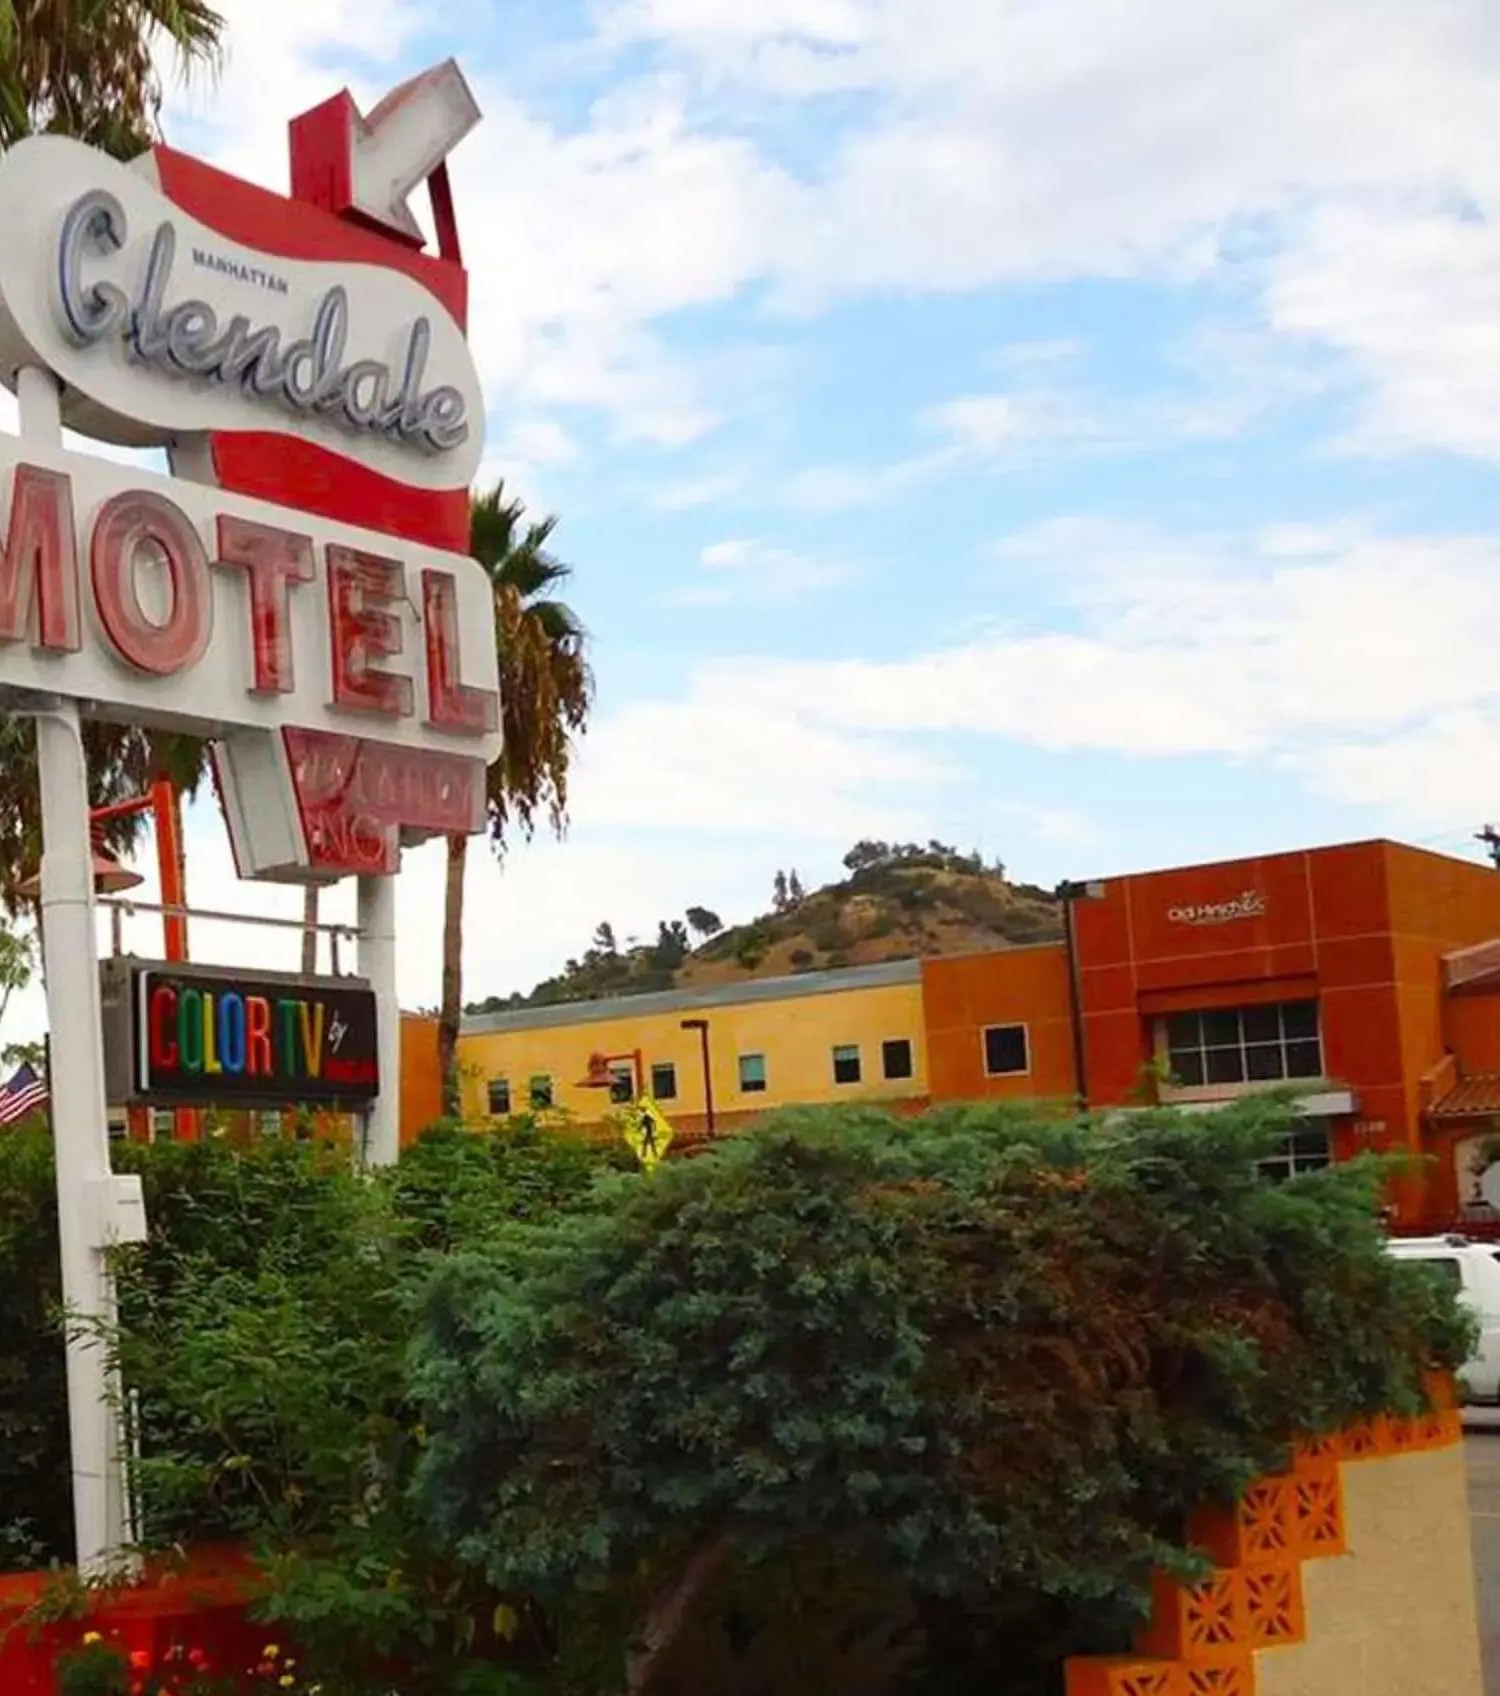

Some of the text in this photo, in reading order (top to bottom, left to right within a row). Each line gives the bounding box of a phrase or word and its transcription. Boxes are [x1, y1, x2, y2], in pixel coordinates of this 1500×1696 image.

[192, 247, 288, 296] MANHATTAN
[59, 188, 470, 452] Glendale
[151, 985, 273, 1077] COLOR
[277, 998, 324, 1079] TV
